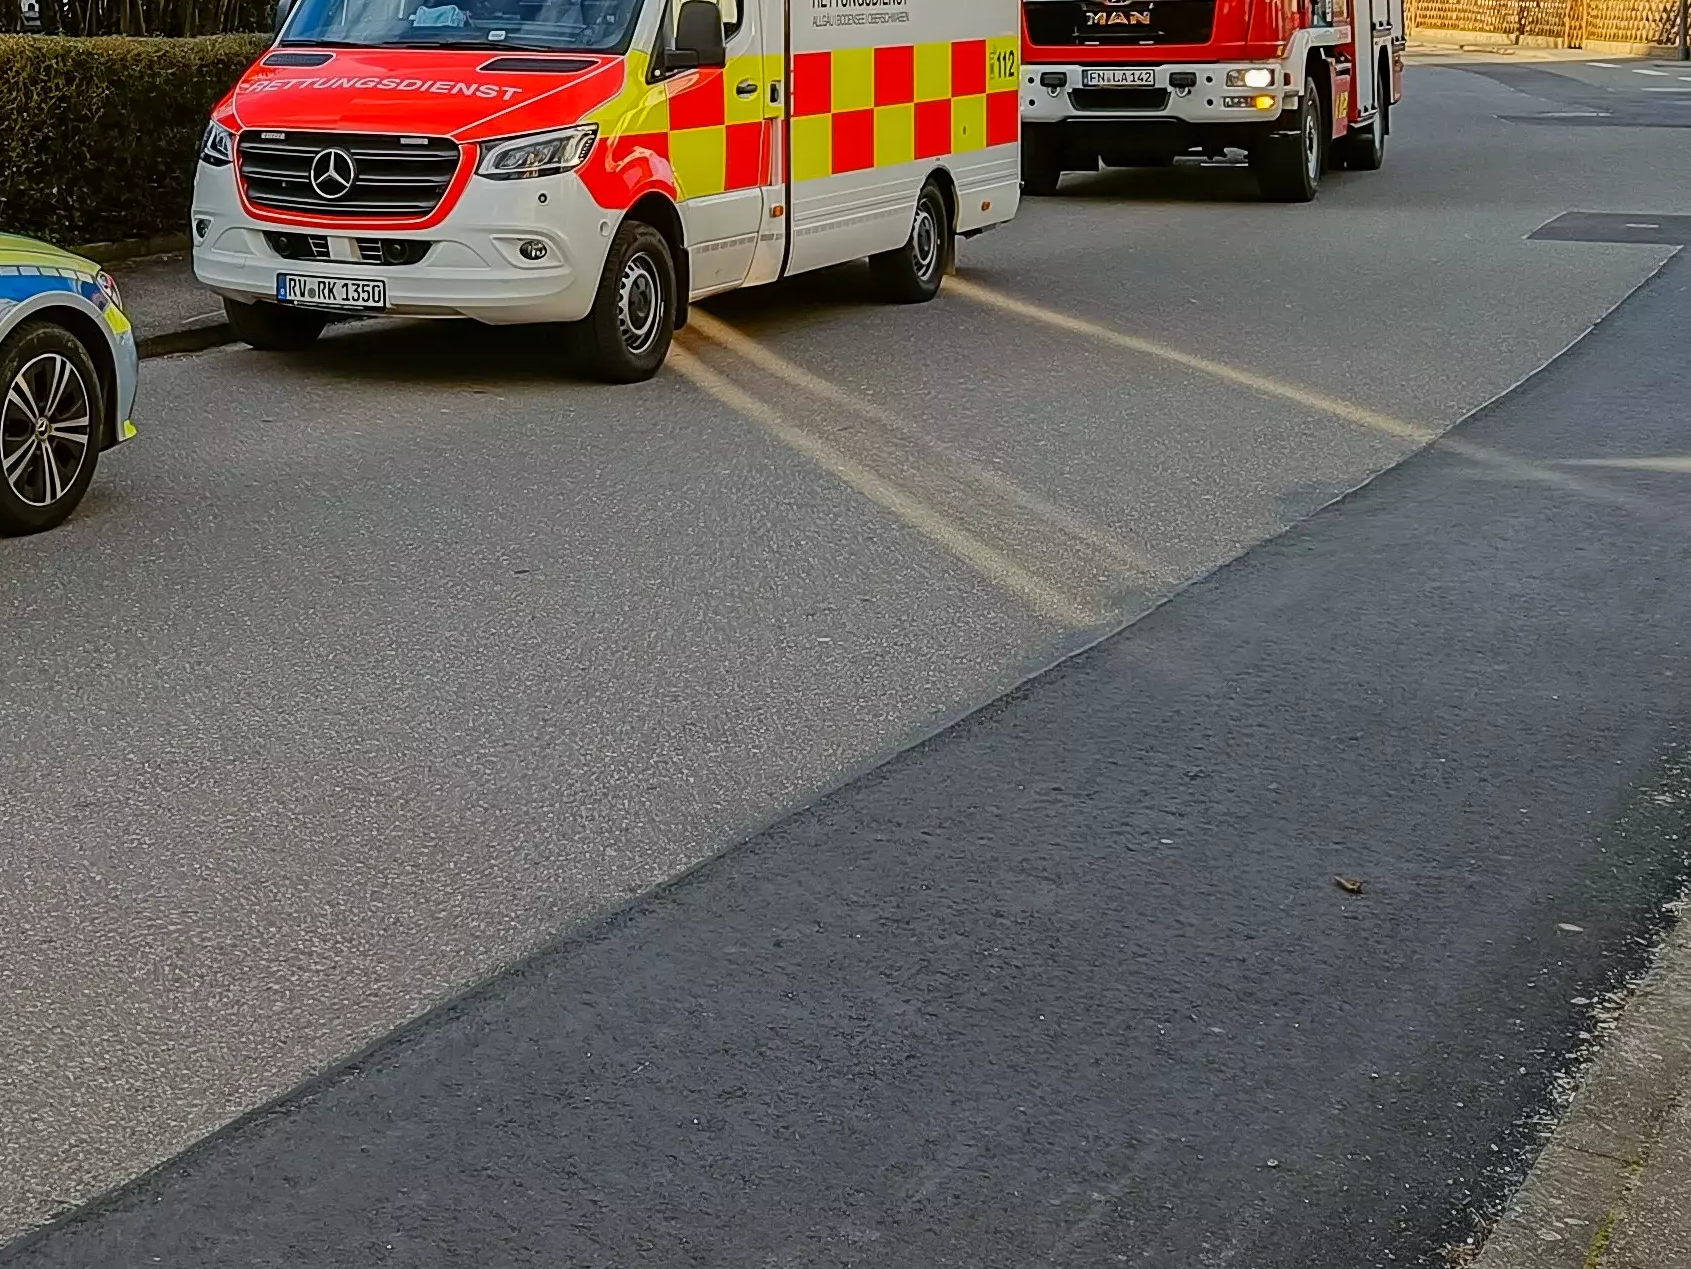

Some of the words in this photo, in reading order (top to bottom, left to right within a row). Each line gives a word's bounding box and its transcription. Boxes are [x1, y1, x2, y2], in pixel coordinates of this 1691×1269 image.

[1085, 11, 1151, 25] MAN
[997, 49, 1015, 78] 112
[247, 77, 522, 101] RETTUNGSDIENST
[1090, 72, 1105, 83] FN
[1113, 72, 1128, 83] LA
[1130, 72, 1152, 83] 142
[288, 278, 307, 298] RV
[317, 281, 337, 300] RK
[341, 282, 382, 304] 1350
